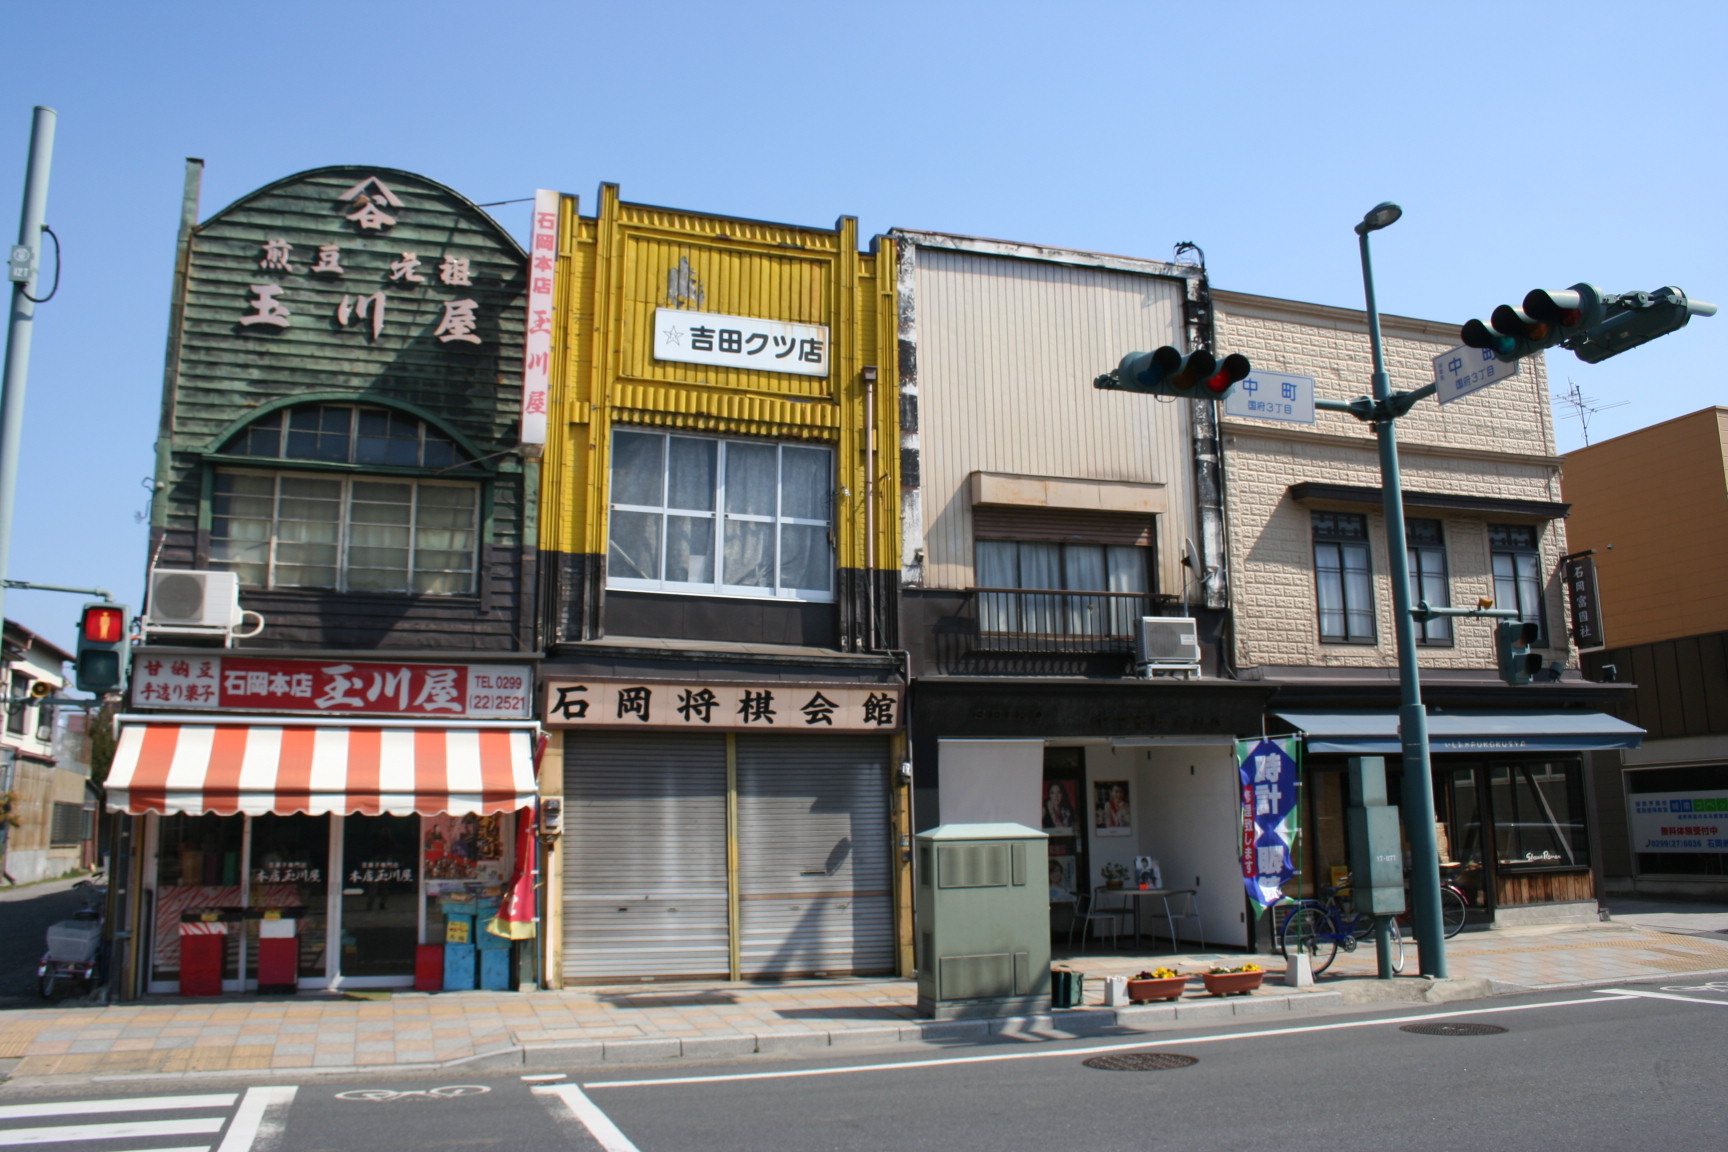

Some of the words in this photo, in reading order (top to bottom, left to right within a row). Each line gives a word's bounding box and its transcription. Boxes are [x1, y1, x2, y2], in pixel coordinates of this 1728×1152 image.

[533, 211, 556, 295] 石岡本店
[239, 284, 482, 345] 玉川屋
[524, 310, 552, 415] 玉川屋
[690, 325, 824, 364] 吉田クツ店
[1247, 400, 1293, 415] 国府3丁目
[144, 660, 215, 678] 甘納豆
[224, 670, 314, 698] 石岡本店
[314, 663, 464, 712] 玉川屋
[474, 674, 494, 689] TEL
[495, 675, 522, 690] 0299
[140, 681, 215, 703] 手造り菓子
[468, 694, 526, 711] (22)2521
[550, 685, 897, 726] 石岡将棋会館
[1254, 752, 1282, 816] 時計
[349, 868, 414, 883] 本店玉川屋
